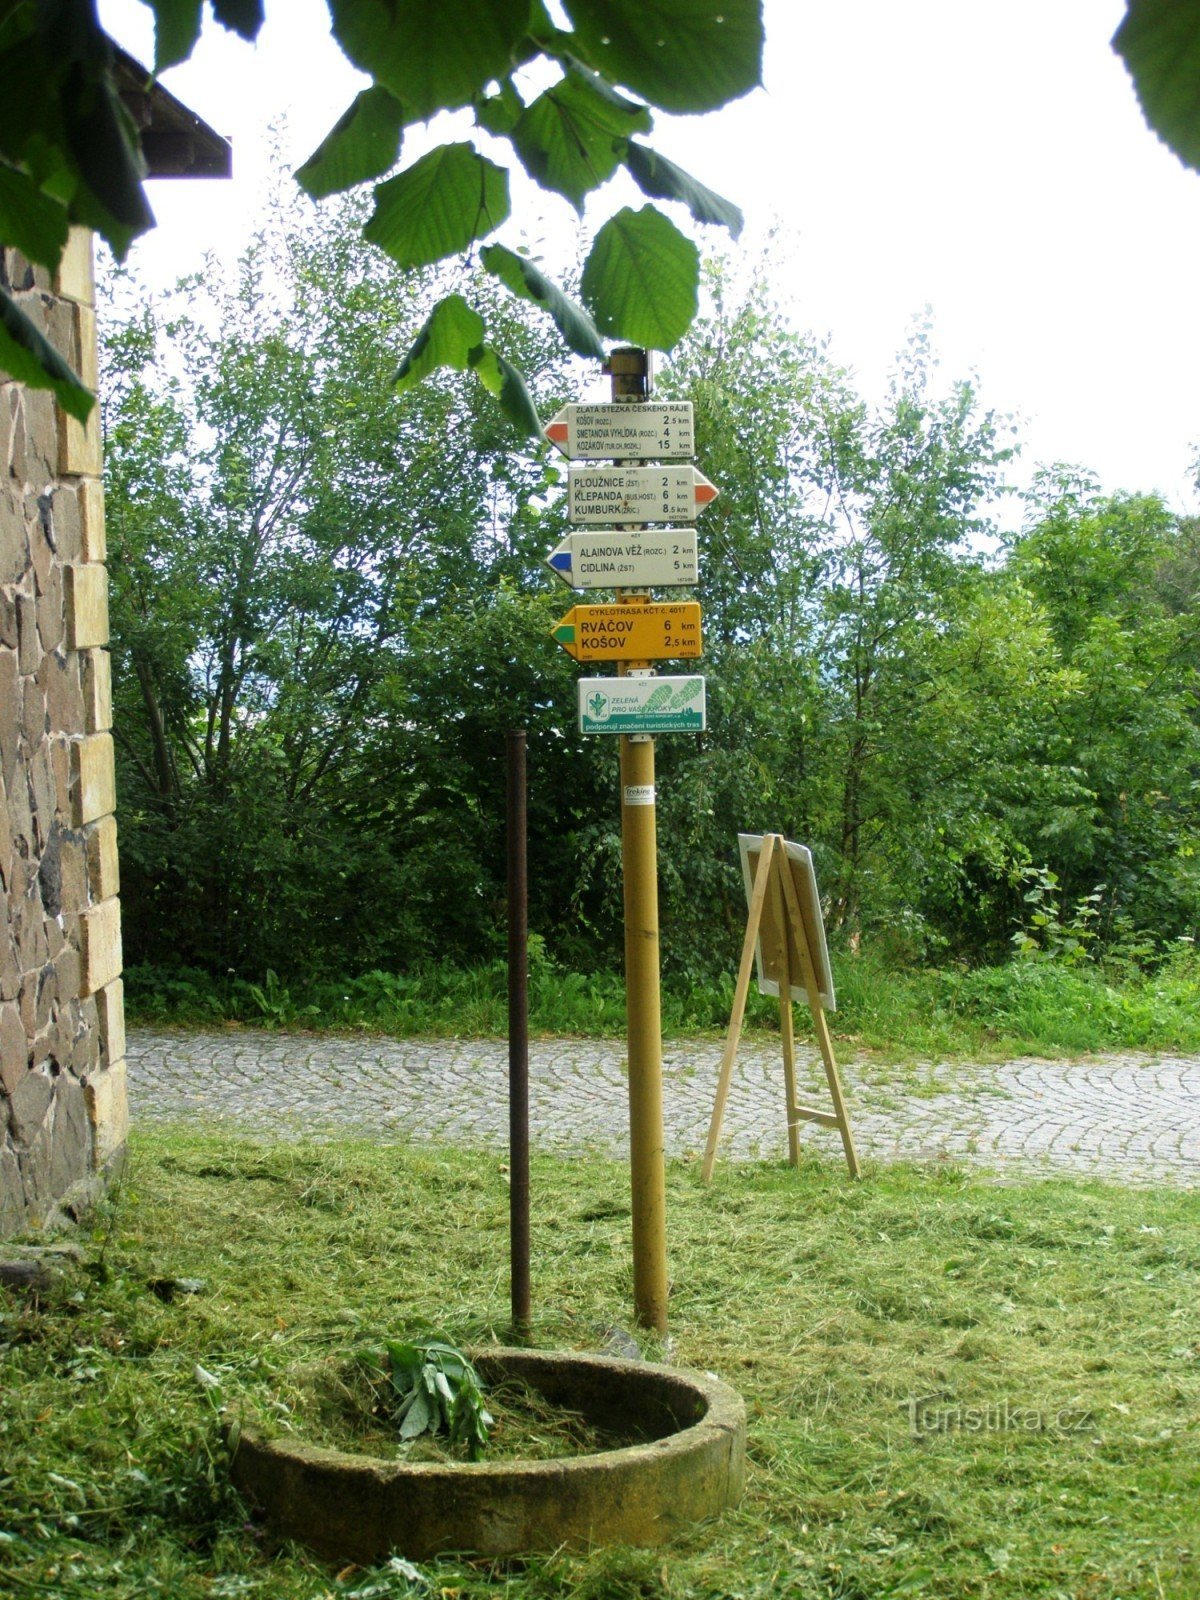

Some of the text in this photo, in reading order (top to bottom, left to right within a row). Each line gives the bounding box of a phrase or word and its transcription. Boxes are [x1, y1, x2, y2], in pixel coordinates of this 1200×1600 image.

[576, 404, 689, 414] ZLATÁ STEZKA ČESKÉHO RÁJE
[576, 414, 594, 425] KOŠOV
[576, 429, 609, 439] SMETANOVA
[611, 427, 637, 438] VYHLÍDKA
[663, 428, 670, 437] 4
[576, 440, 605, 451] KOZÁKOV
[658, 440, 670, 449] 15
[574, 476, 625, 488] PLOUŽNICE
[662, 477, 669, 487] 2
[574, 490, 623, 502] KLEPANDA
[662, 490, 669, 499] 6
[574, 504, 621, 515] KUMBURK
[580, 547, 624, 558] ALAINOVA
[625, 544, 642, 556] VĚŽ
[672, 545, 679, 554] 2
[580, 562, 616, 573] CIDLINA
[617, 564, 635, 573] (ŽST)
[673, 560, 680, 570] 5
[588, 607, 641, 616] CYKLOTRASA
[643, 606, 659, 615] KČT
[669, 606, 686, 614] 4017
[580, 620, 695, 633] RVÁČOV 6 km
[581, 635, 696, 649] KOŠOV 2,5 km
[611, 696, 639, 704] ZELENÁ
[585, 722, 618, 731] podporují
[619, 721, 645, 730] značení
[646, 721, 685, 730] turistických
